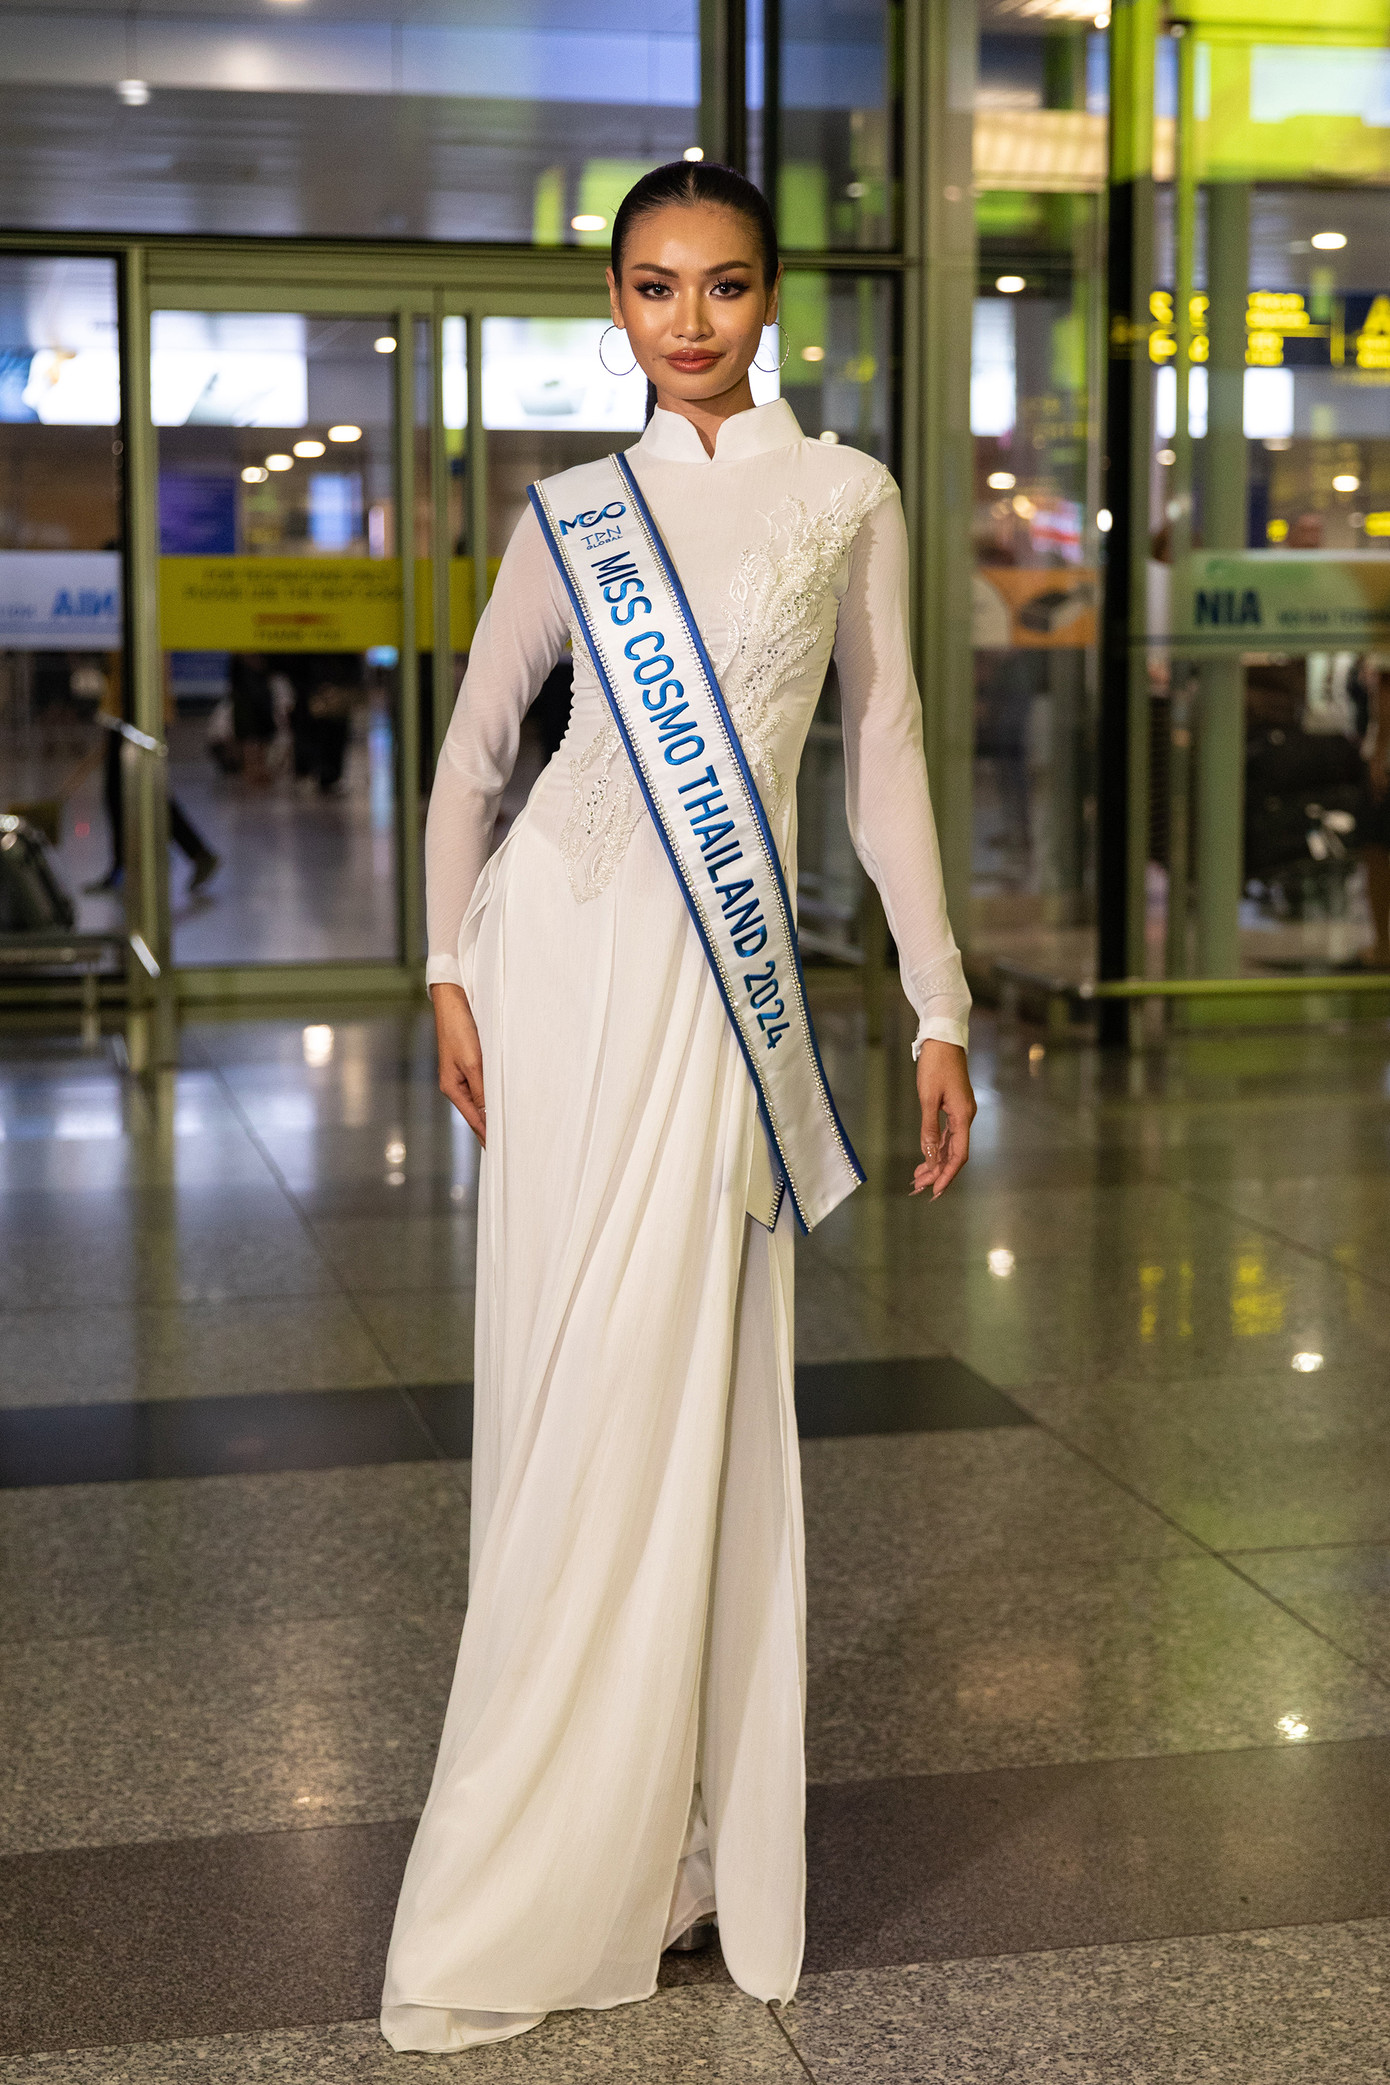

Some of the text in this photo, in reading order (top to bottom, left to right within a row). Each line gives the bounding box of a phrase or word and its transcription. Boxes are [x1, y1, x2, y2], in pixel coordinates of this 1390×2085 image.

[580, 525, 622, 546] TPN
[586, 535, 624, 551] GLOBAL
[1194, 588, 1262, 626] NIA
[590, 550, 790, 1050] MISS COSMO THAILAND 2024
